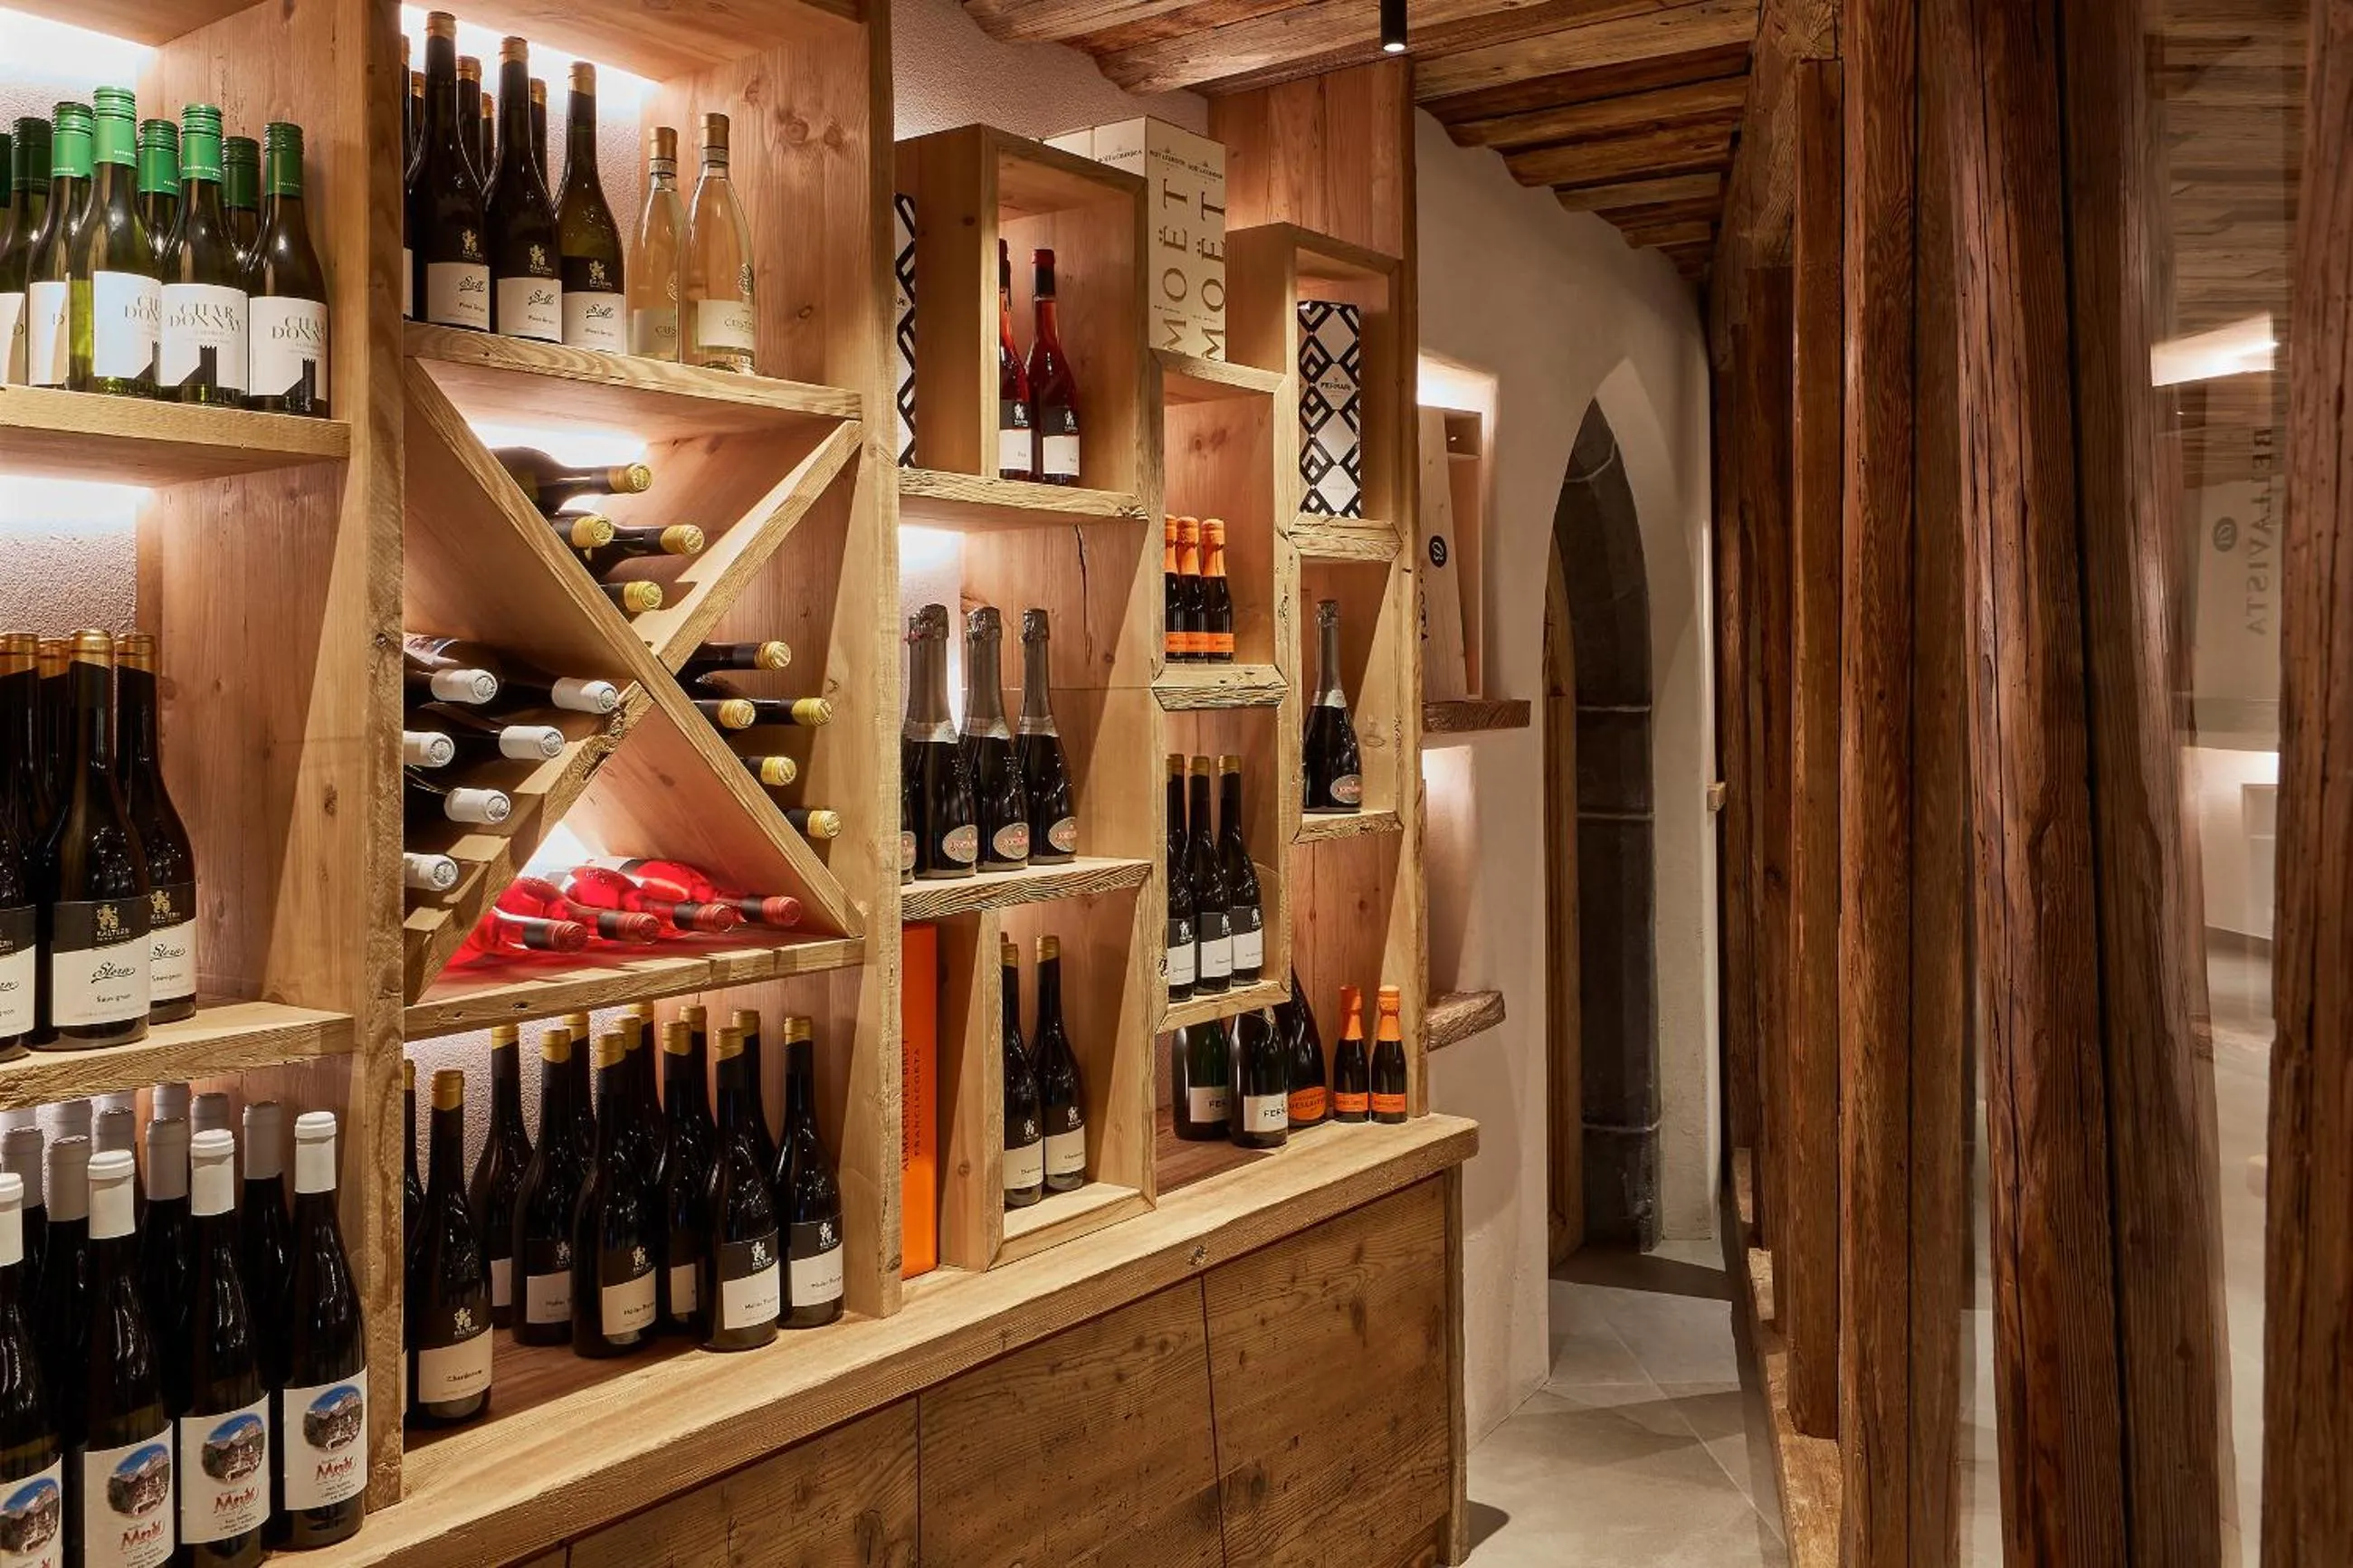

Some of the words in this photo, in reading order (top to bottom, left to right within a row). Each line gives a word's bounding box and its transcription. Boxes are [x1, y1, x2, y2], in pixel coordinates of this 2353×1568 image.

[181, 302, 233, 321] CHAR
[1159, 177, 1188, 351] MOËT
[1196, 190, 1225, 362] MOËT
